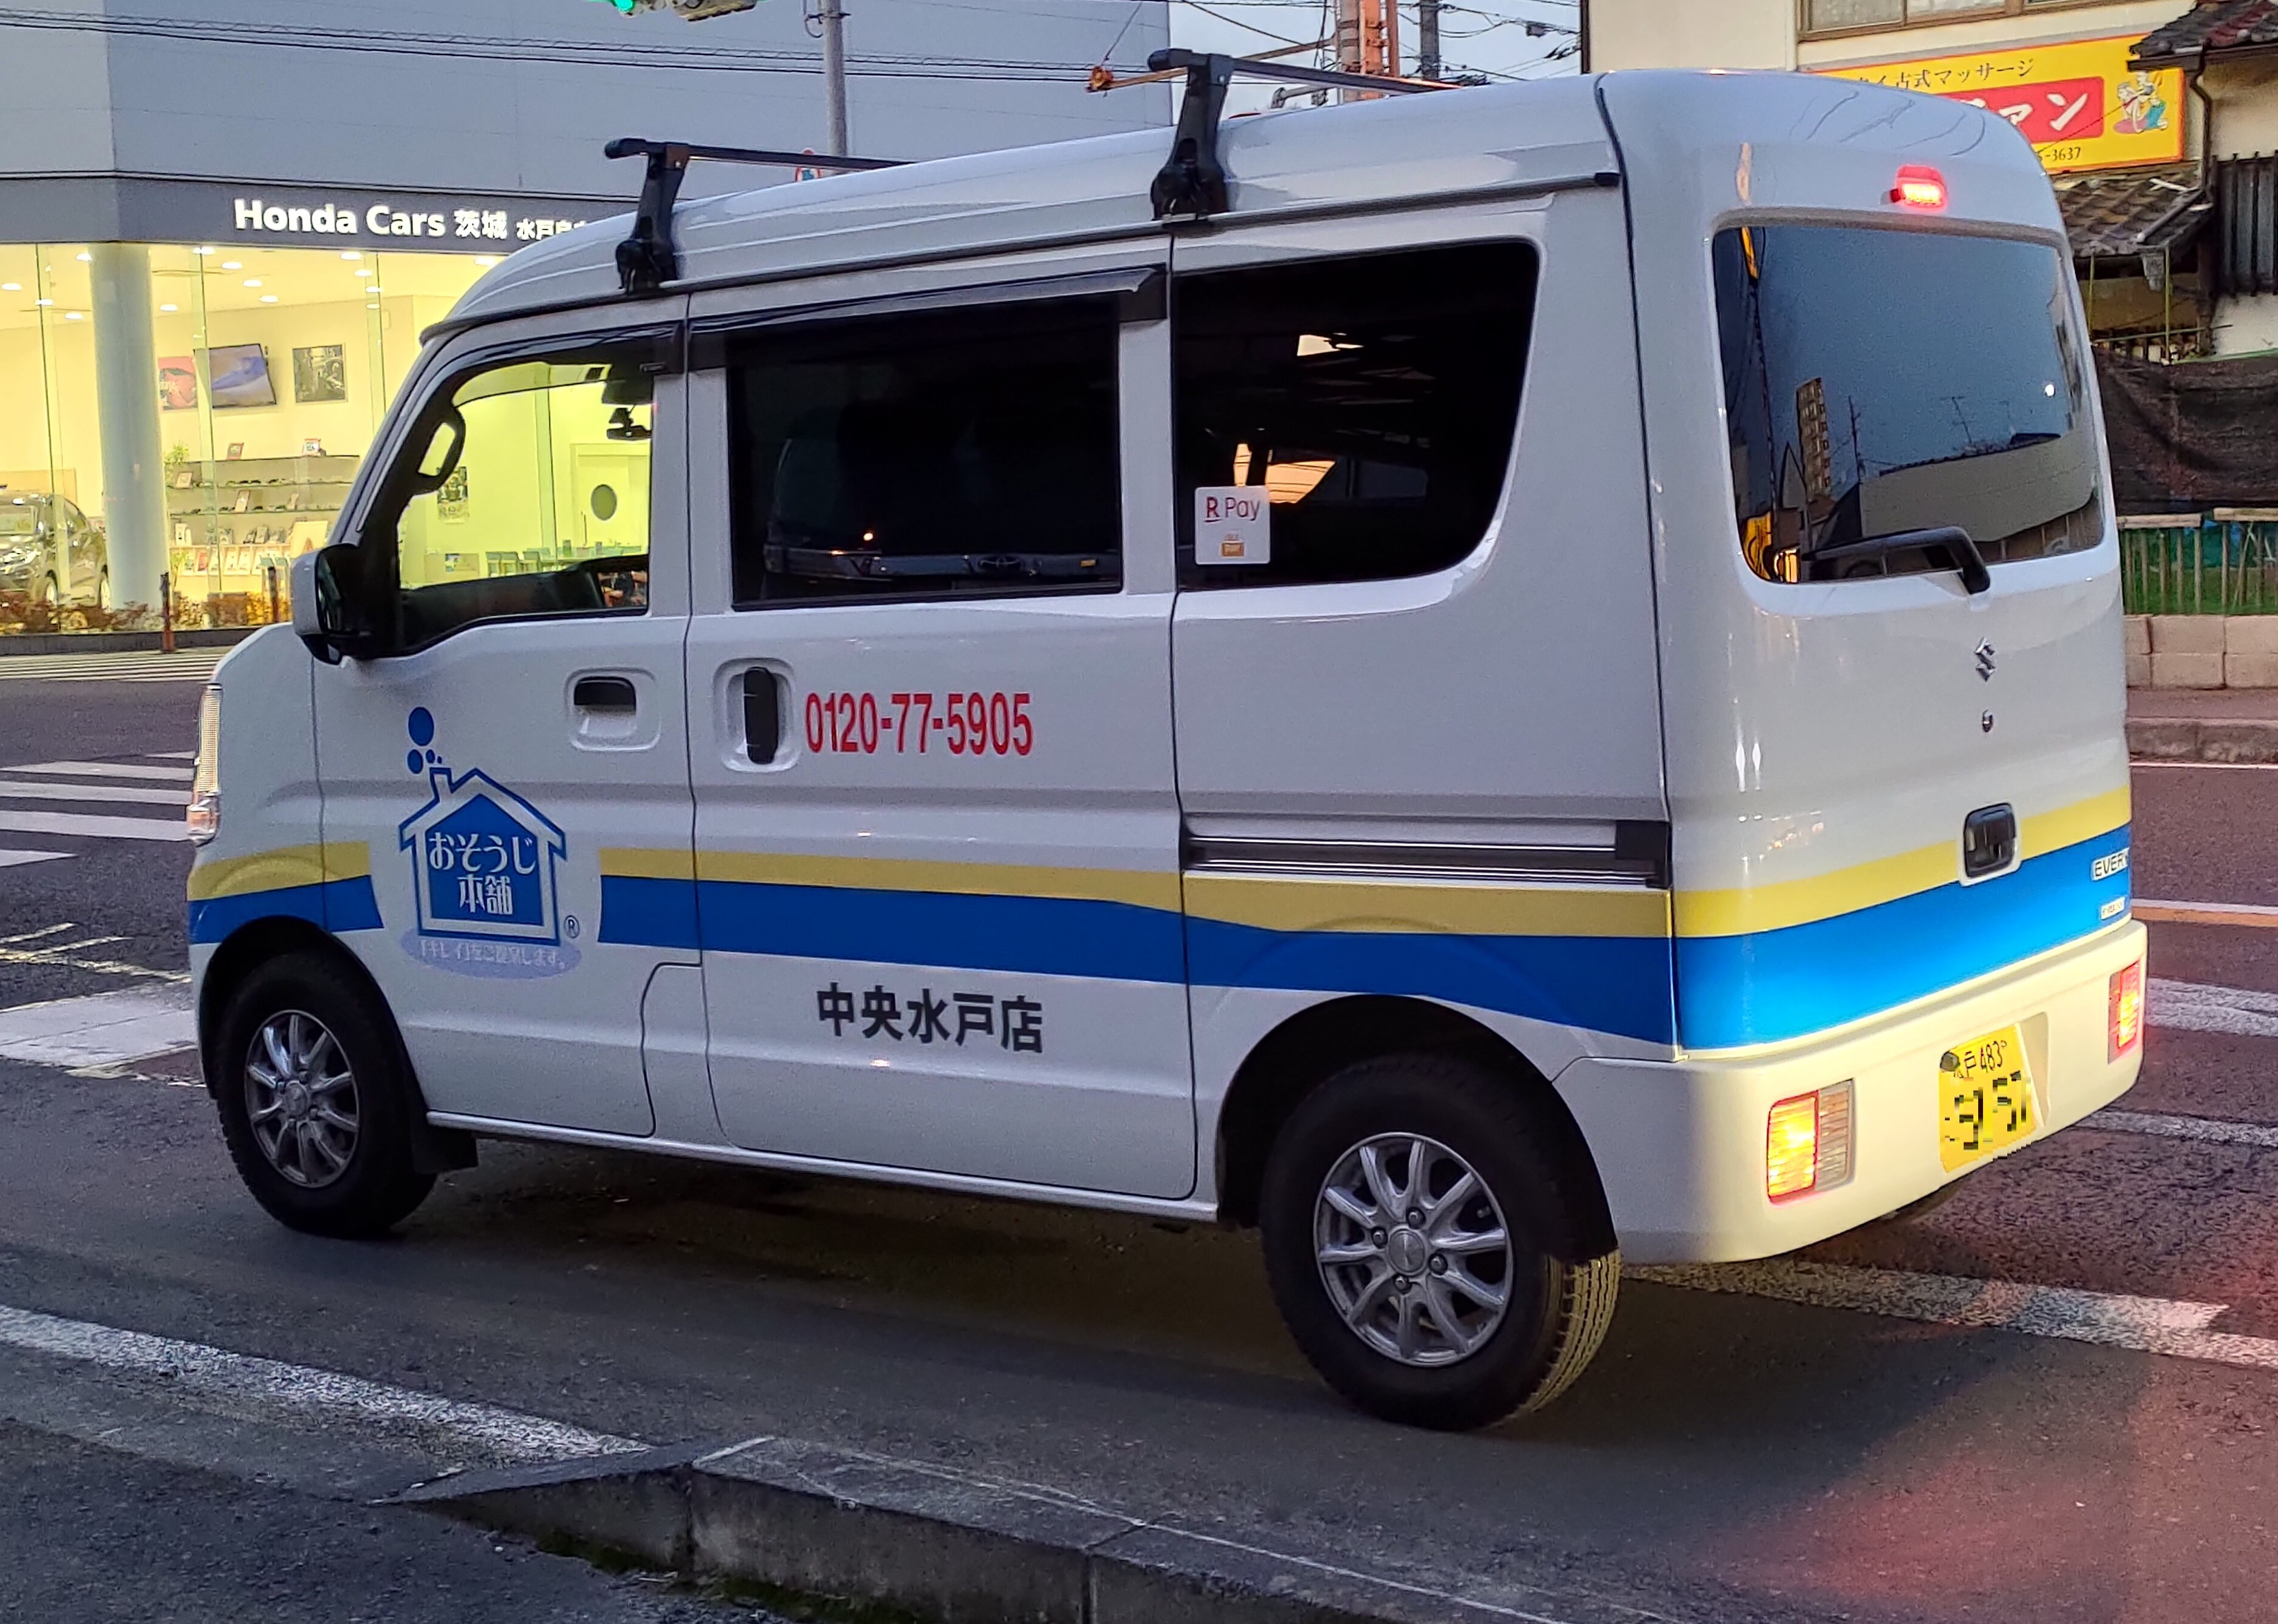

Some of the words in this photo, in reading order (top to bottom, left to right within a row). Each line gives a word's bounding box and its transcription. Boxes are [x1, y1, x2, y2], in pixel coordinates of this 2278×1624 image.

[1859, 58, 2034, 93] 古式マッサージ
[1961, 93, 2088, 131] ァン
[234, 199, 358, 234] Honda
[365, 205, 446, 237] Cars
[454, 210, 508, 240] 茨城
[516, 217, 586, 240] 水戸
[1204, 496, 1222, 523] R
[1225, 497, 1260, 522] Pay
[806, 692, 1034, 756] 0120-77-5905
[429, 832, 535, 874] おそうじ
[458, 874, 513, 915] 本舗
[816, 982, 1043, 1053] 中央水戸店
